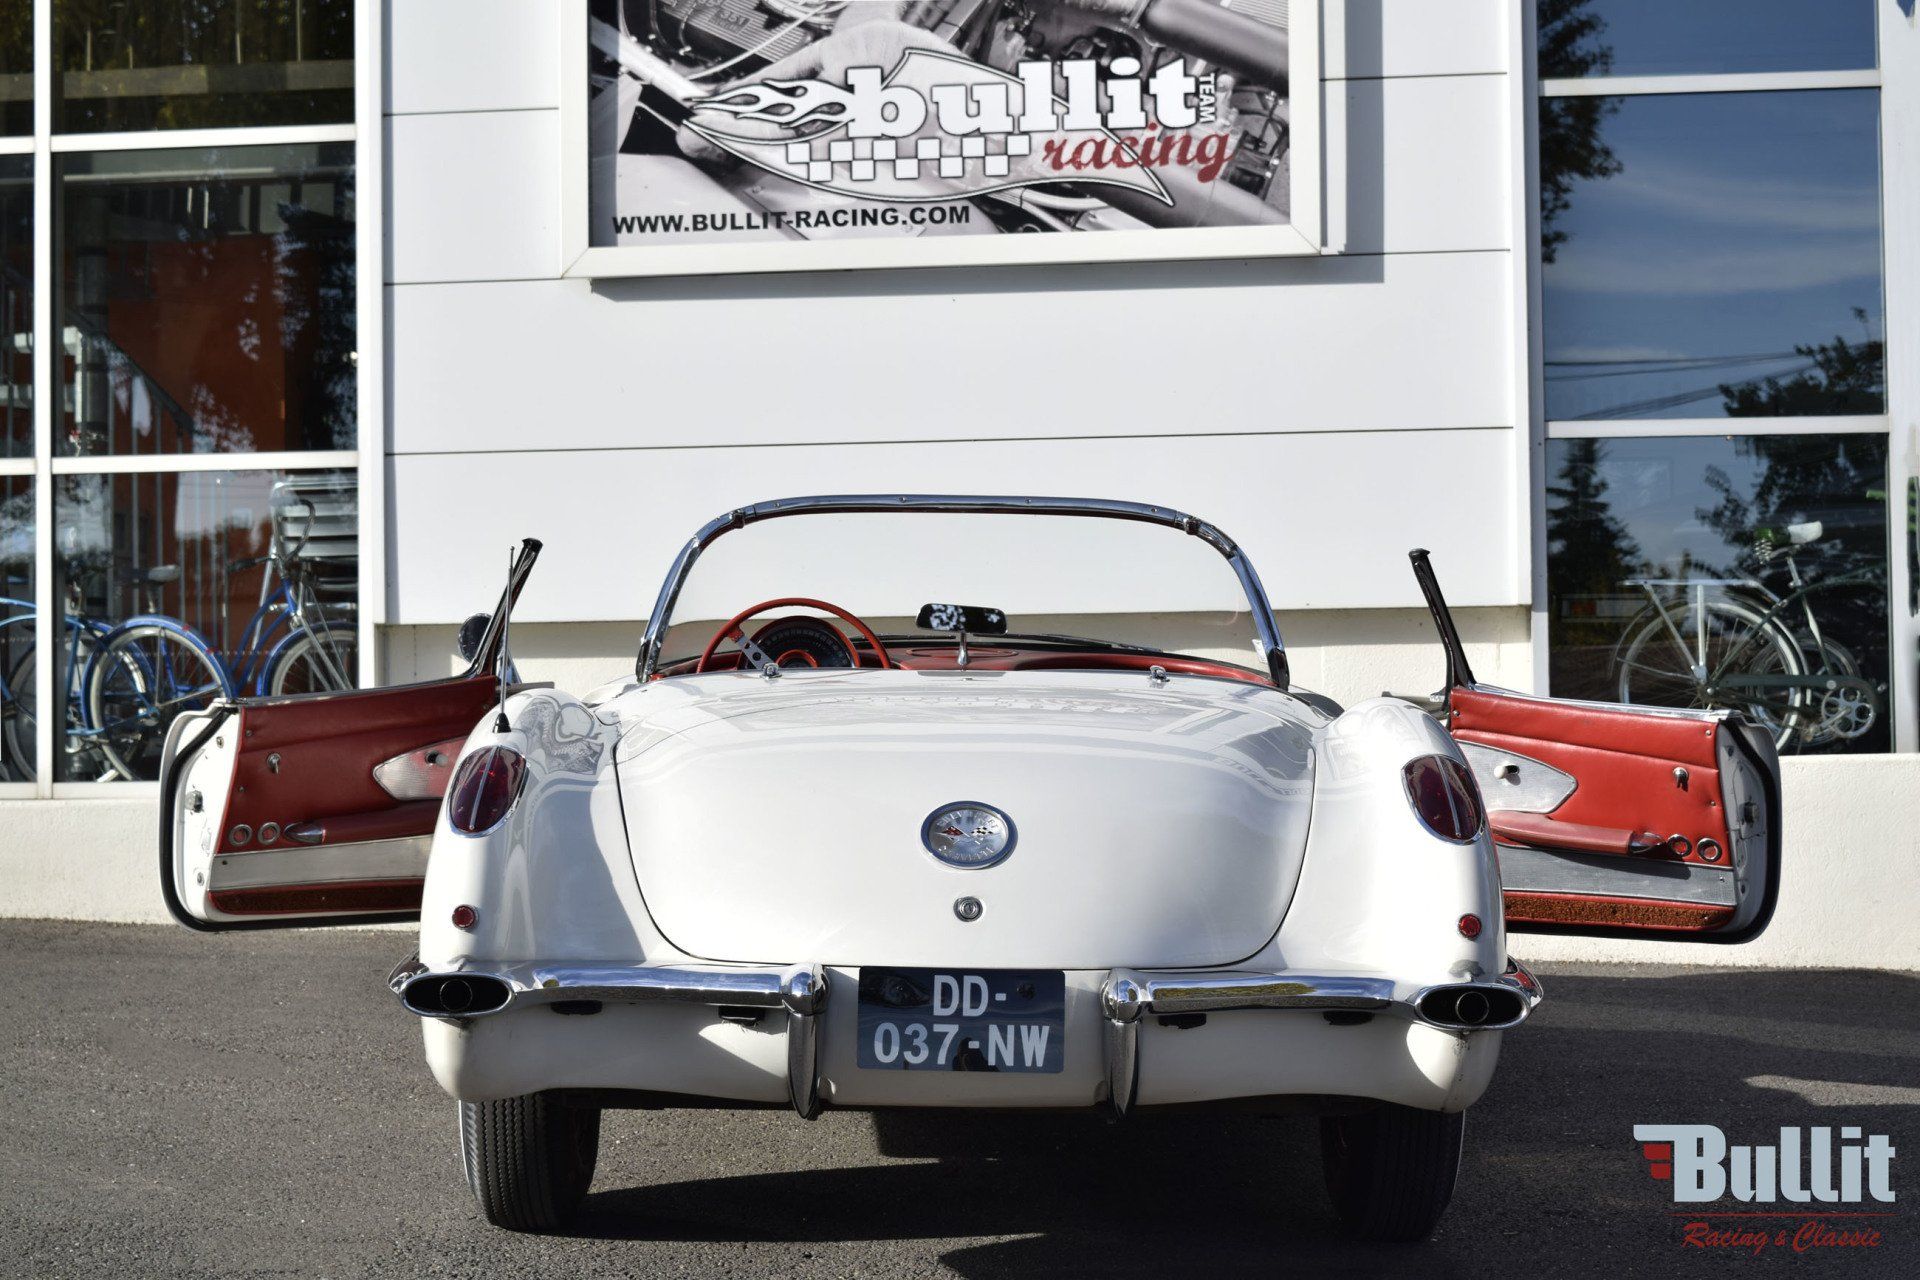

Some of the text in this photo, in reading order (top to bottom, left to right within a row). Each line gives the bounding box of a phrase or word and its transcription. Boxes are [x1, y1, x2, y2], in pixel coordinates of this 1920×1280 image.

[847, 57, 1197, 138] bullit
[1199, 73, 1216, 124] TEAM
[1040, 122, 1235, 184] racing
[612, 205, 971, 234] WWW.BULLIT-RACING.COM
[932, 974, 1007, 1017] DD-
[873, 1022, 1050, 1068] 037-NW
